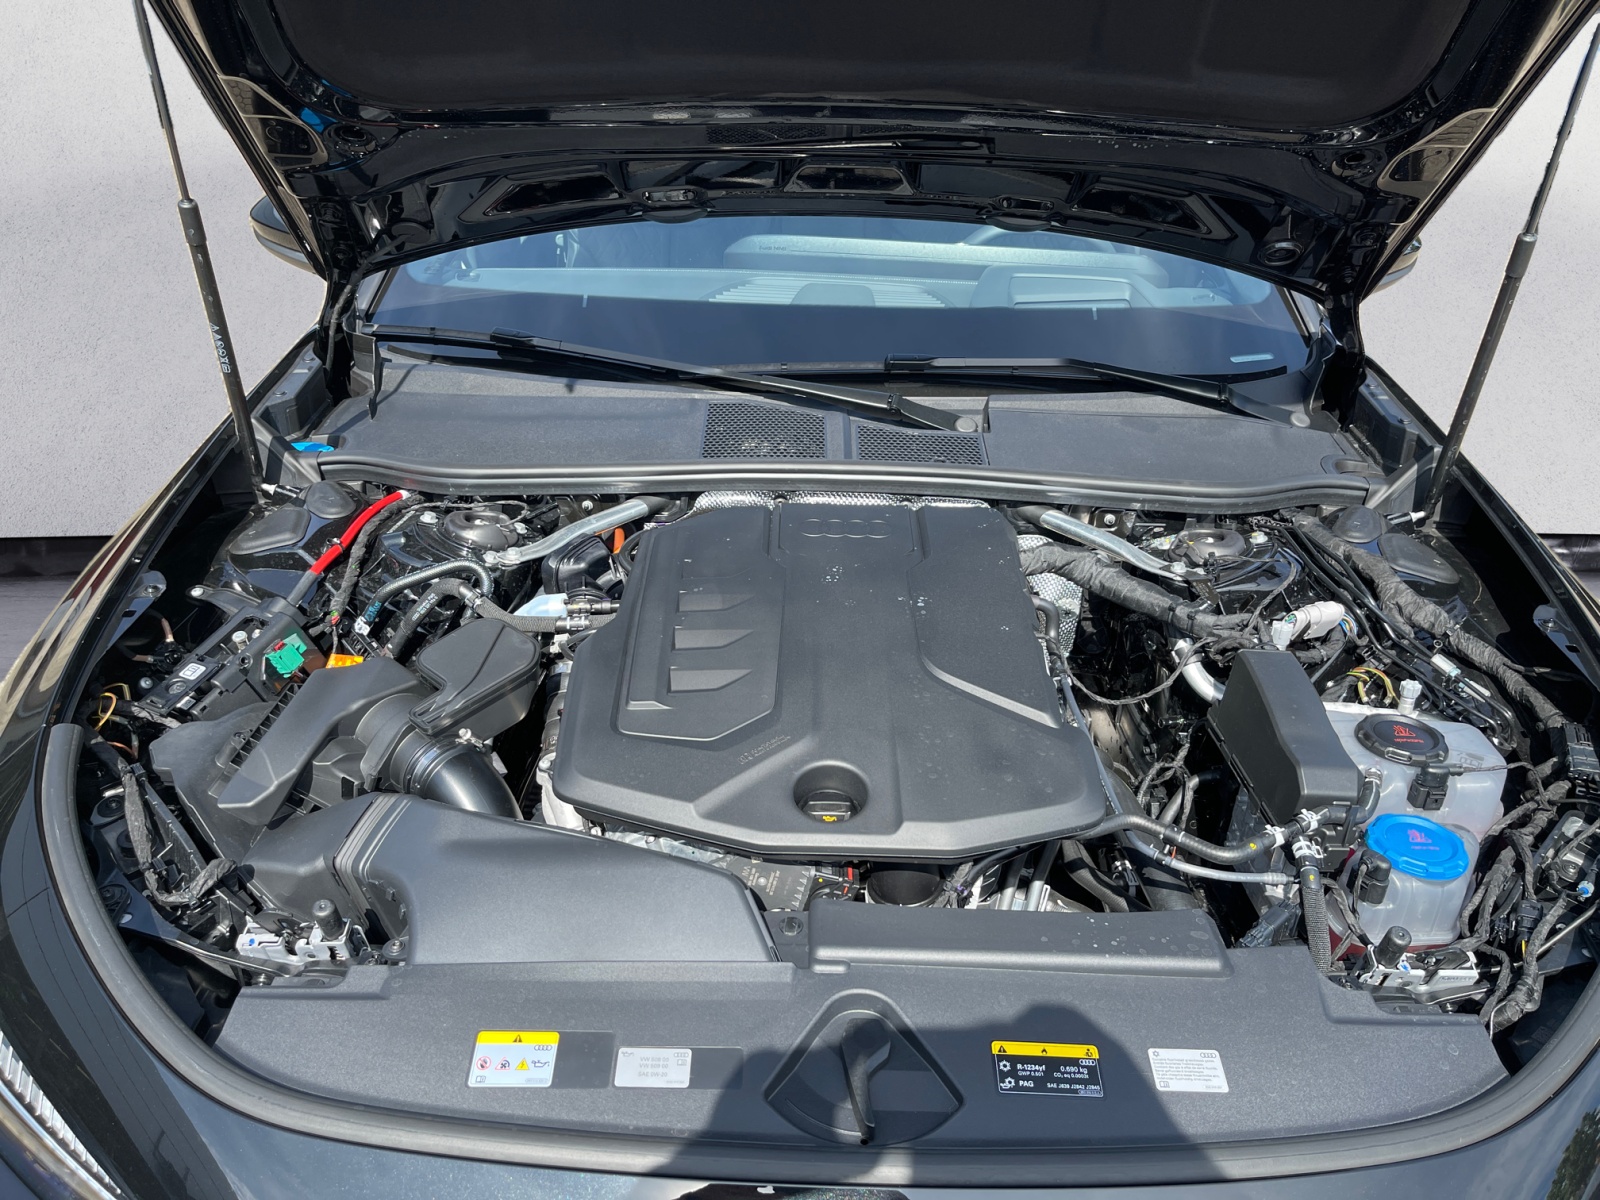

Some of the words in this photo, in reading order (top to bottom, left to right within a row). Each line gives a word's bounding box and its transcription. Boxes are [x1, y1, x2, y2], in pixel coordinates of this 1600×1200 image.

[1016, 1063, 1046, 1072] R-1234yf
[1079, 1065, 1088, 1074] kg
[1018, 1080, 1034, 1088] PAG
